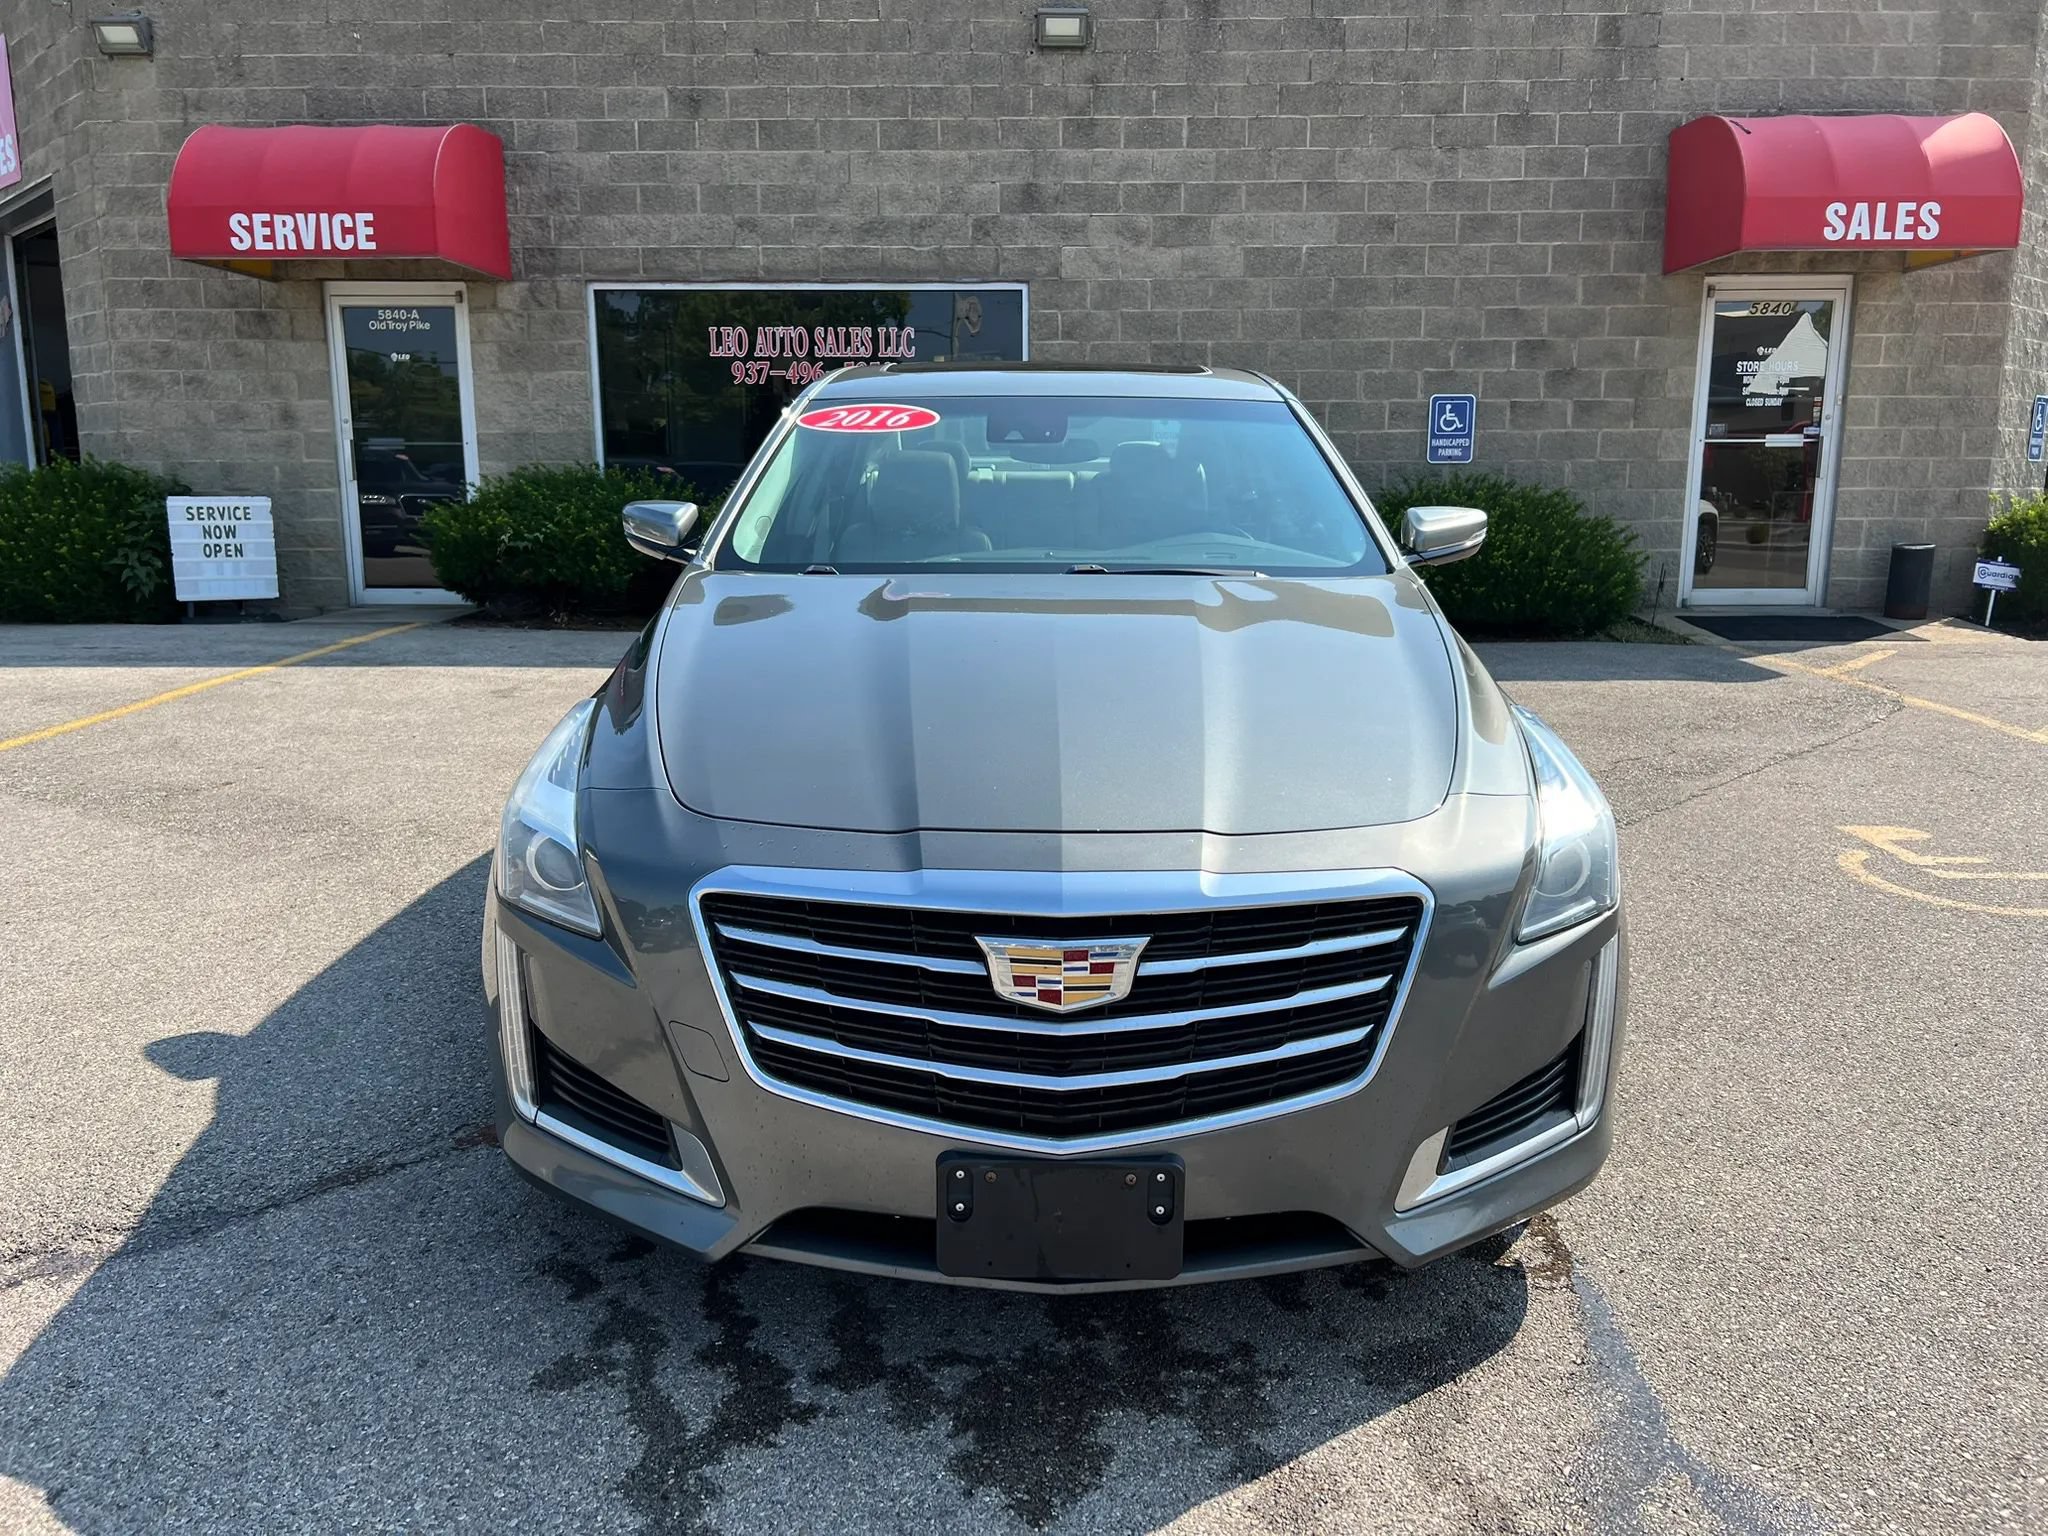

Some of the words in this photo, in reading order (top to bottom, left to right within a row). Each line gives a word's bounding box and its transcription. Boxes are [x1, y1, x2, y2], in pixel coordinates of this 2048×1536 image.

[1823, 201, 1941, 241] SALES
[228, 212, 377, 251] SERVICE
[377, 309, 420, 320] 5840-A
[1749, 302, 1792, 315] 5840
[368, 320, 387, 330] Old
[387, 320, 408, 332] Troy
[409, 320, 431, 330] Pike
[708, 326, 749, 358] LEO
[754, 326, 809, 358] AUTO
[814, 326, 872, 358] SALES
[877, 326, 916, 358] LLC
[1736, 361, 1766, 372] STORE
[1769, 361, 1799, 372] HOURS
[817, 408, 915, 427] 2016
[1431, 438, 1471, 447] HANDICAPPED
[1437, 448, 1463, 457] PARKING
[185, 506, 252, 521] SERVICE
[202, 525, 237, 540] NOW
[203, 543, 244, 558] OPEN
[1977, 566, 2016, 580] Guardia
